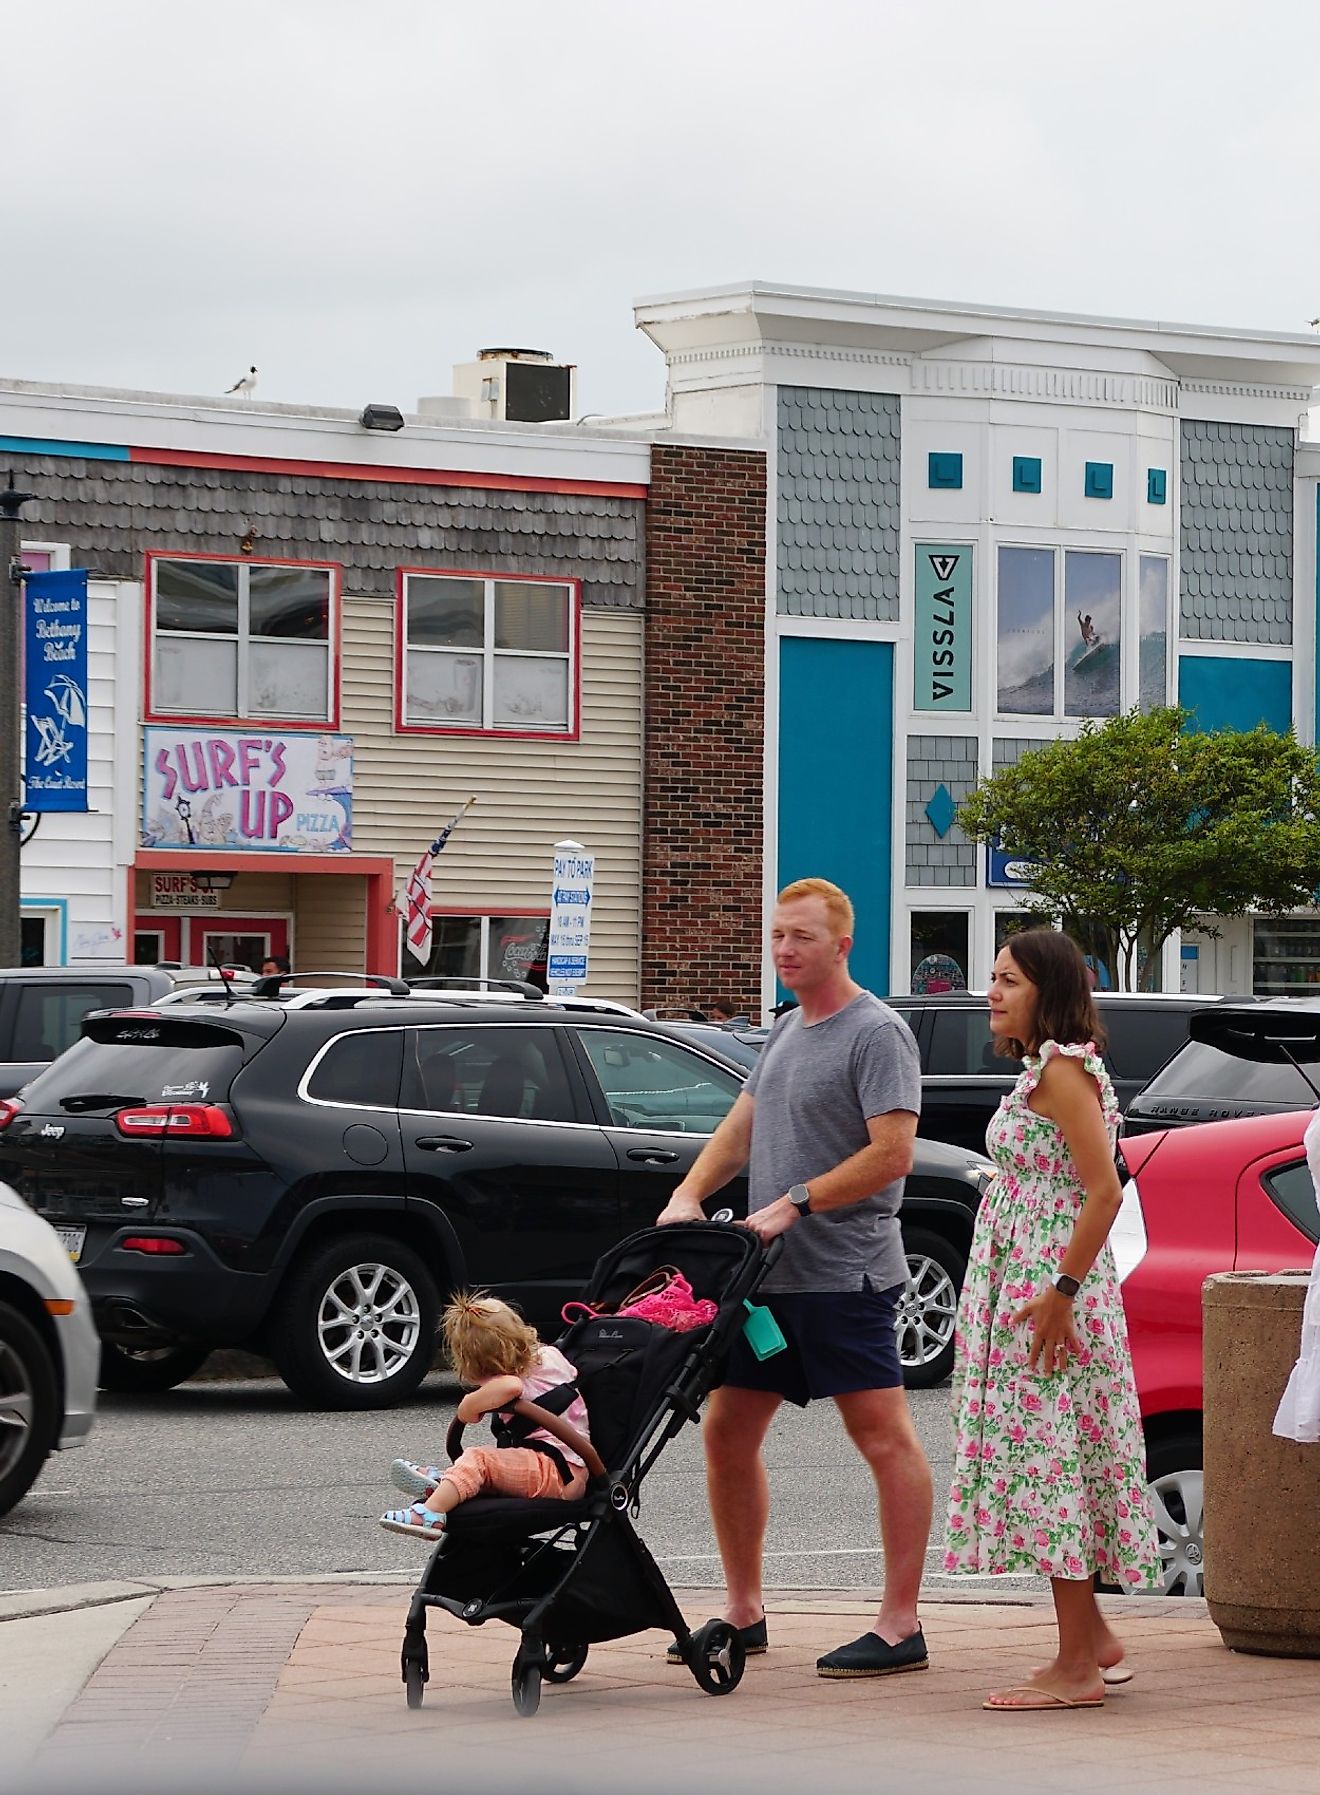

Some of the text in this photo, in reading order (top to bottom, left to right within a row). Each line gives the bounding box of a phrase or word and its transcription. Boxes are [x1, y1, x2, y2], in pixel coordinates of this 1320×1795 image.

[36, 619, 81, 642] Bethany
[44, 641, 76, 661] Beach
[932, 587, 955, 701] VISSLA
[155, 739, 287, 800] SURF'S
[239, 789, 294, 839] UP
[296, 813, 340, 833] PIZZA
[555, 859, 593, 878] PAY TO PARK
[155, 876, 198, 893] SURF'S
[1151, 1105, 1200, 1117] RANGE
[41, 1123, 65, 1140] Jeep
